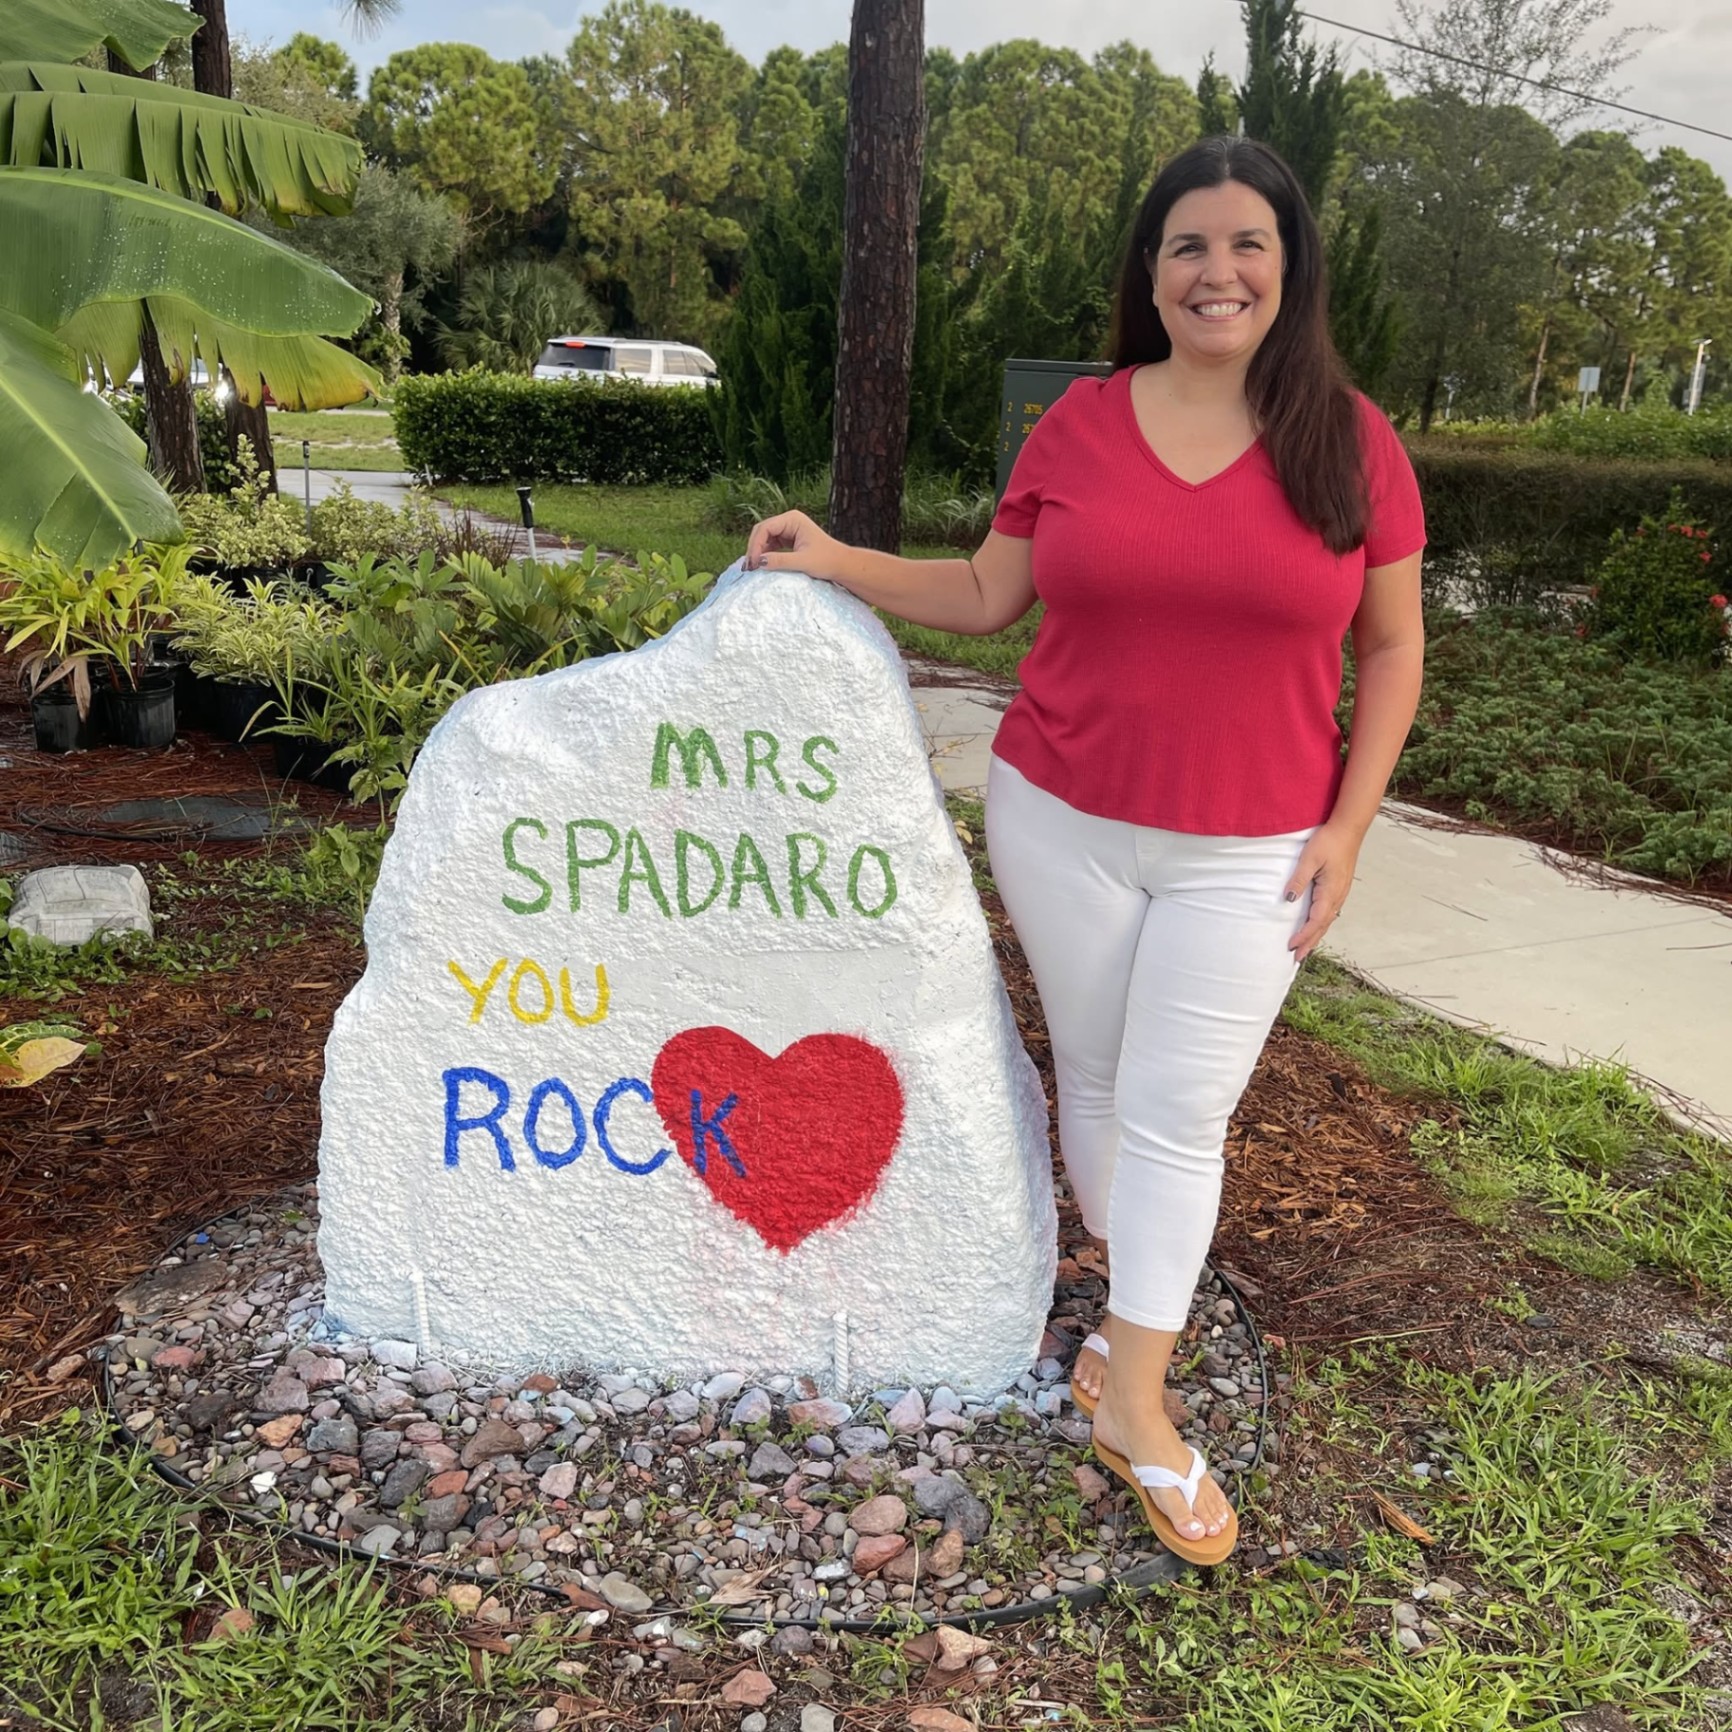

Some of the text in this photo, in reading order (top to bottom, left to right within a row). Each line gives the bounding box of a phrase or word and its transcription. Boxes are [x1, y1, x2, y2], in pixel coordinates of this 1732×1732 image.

[1005, 421, 1012, 432] 2
[1007, 401, 1013, 413] 2
[1003, 441, 1010, 452] 2
[650, 722, 840, 803] MRS
[502, 817, 899, 919] SPADARO
[447, 957, 611, 1027] YOU
[442, 1066, 747, 1178] ROCK
